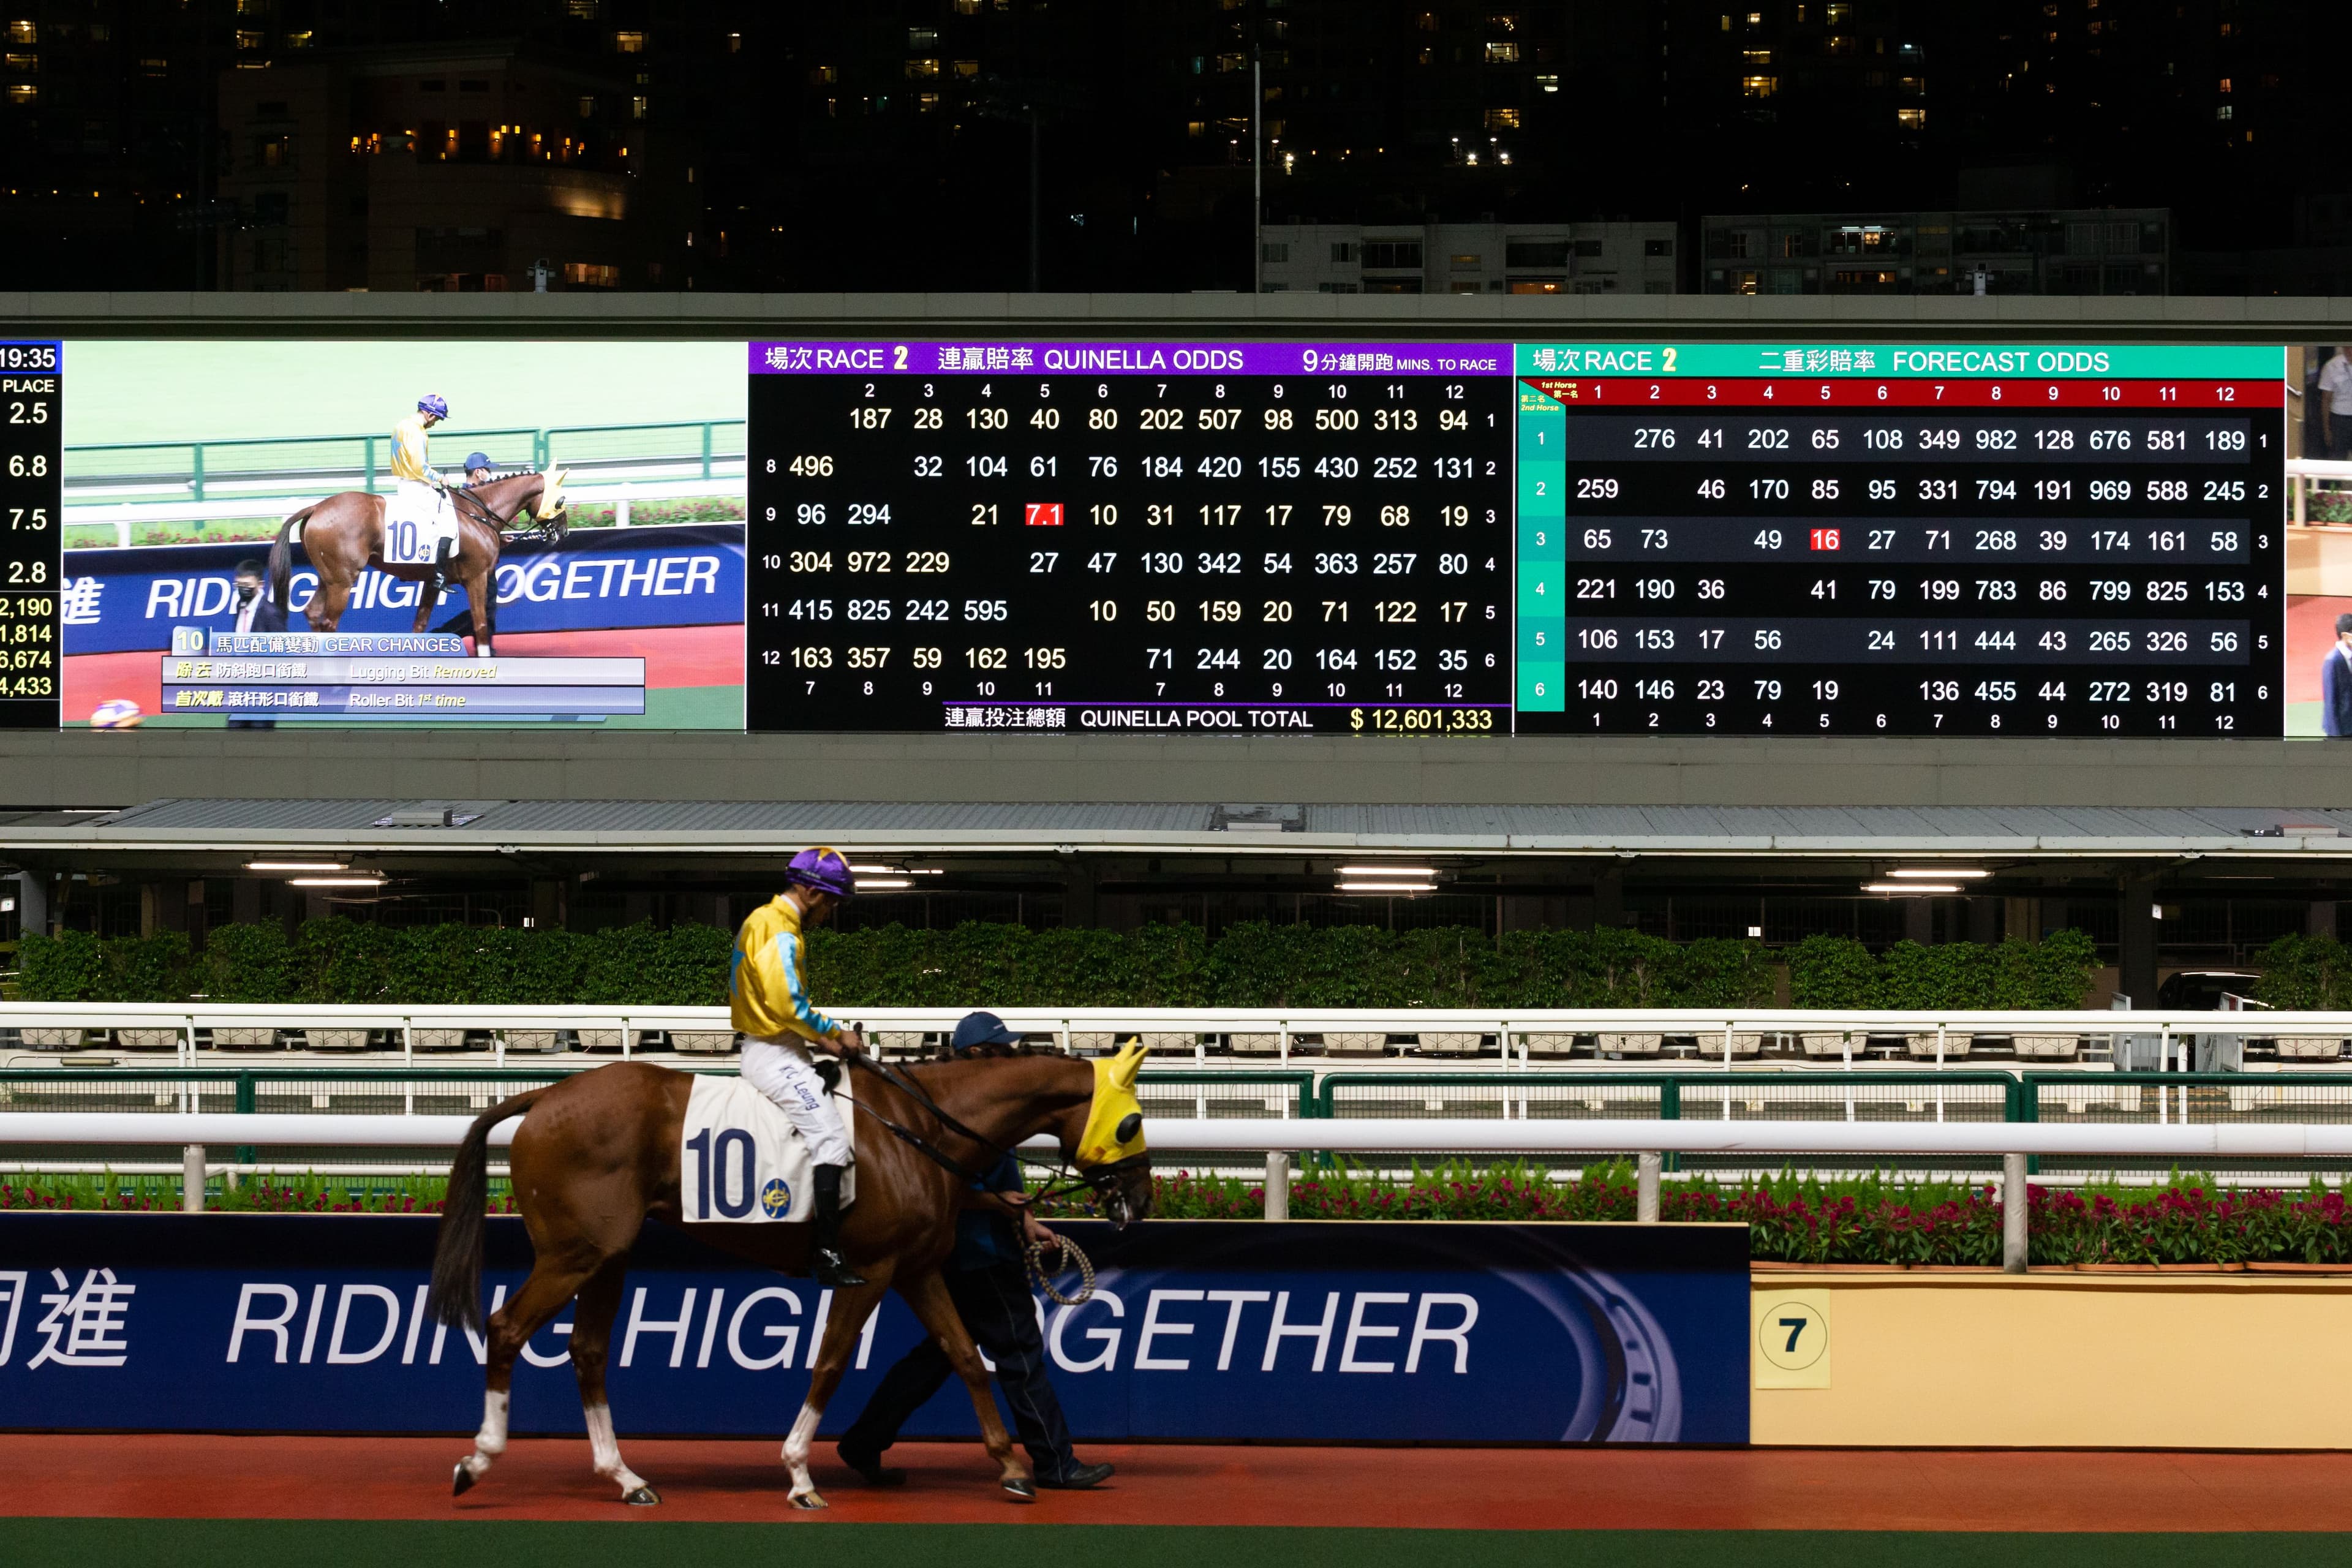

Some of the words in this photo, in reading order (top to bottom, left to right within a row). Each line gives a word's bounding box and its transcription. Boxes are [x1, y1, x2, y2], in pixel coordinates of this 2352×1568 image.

[0, 348, 56, 368] 19:35
[766, 347, 812, 370] 場次
[817, 349, 884, 369] RACE
[894, 345, 908, 370] 2
[938, 347, 1034, 371] 連贏賠率
[1044, 349, 1167, 370] QUINELLA
[1173, 350, 1243, 370] ODDS
[1396, 360, 1433, 371] MINS.
[1437, 359, 1457, 371] TO
[1460, 359, 1497, 371] RACE
[1532, 349, 1580, 372] 場次
[1585, 350, 1652, 371] RACE
[1662, 347, 1677, 372] 2
[1759, 349, 1875, 372] 二重彩賠率
[1894, 351, 2030, 372] FORECAST
[2037, 352, 2109, 372] ODDS
[3, 379, 55, 393] PLACE
[865, 383, 875, 398] 2
[924, 383, 933, 398] 3
[981, 383, 992, 398] 4
[1040, 383, 1050, 398] 5
[1098, 383, 1108, 398] 6
[1157, 384, 1167, 398] 7
[1215, 384, 1226, 398] 8
[1273, 384, 1283, 398] 9
[1329, 384, 1347, 399] 10
[1387, 385, 1403, 399] 11
[1446, 385, 1464, 399] 12
[1594, 385, 1601, 399] 1
[1650, 385, 1660, 399] 2
[1707, 385, 1717, 399] 3
[1763, 385, 1774, 399] 4
[1821, 385, 1831, 400] 5
[1877, 385, 1887, 400] 6
[1934, 386, 1945, 400] 7
[1991, 386, 2002, 400] 8
[2048, 386, 2059, 401] 9
[2102, 386, 2120, 401] 10
[2160, 386, 2176, 401] 11
[2216, 386, 2234, 401] 12
[9, 402, 48, 424] 2.5
[850, 408, 892, 429] 187
[914, 408, 943, 429] 28
[967, 408, 1008, 429] 130
[1030, 409, 1060, 429] 40
[1088, 409, 1118, 430] 80
[1140, 409, 1183, 430] 202
[1198, 409, 1242, 430] 507
[1264, 409, 1293, 430] 98
[1315, 409, 1359, 431] 500
[1374, 409, 1417, 431] 313
[1439, 409, 1468, 431] 94
[1487, 413, 1494, 428] 1
[1537, 431, 1544, 445] 1
[1634, 428, 1675, 448] 276
[1697, 429, 1722, 448] 41
[1747, 429, 1789, 449] 202
[1812, 429, 1839, 449] 65
[1863, 429, 1903, 450] 108
[1919, 429, 1960, 450] 349
[1976, 429, 2017, 450] 982
[2034, 429, 2074, 450] 128
[2089, 430, 2131, 450] 676
[2147, 430, 2185, 450] 581
[2205, 431, 2245, 451] 189
[2260, 434, 2266, 448] 1
[9, 454, 47, 477] 6.8
[9, 508, 47, 530] 7.5
[766, 507, 776, 521] 9
[797, 503, 826, 525] 96
[848, 503, 891, 525] 294
[971, 504, 997, 525] 21
[1027, 504, 1059, 526] 7.1
[1090, 504, 1117, 526] 10
[1147, 505, 1172, 526] 31
[1199, 505, 1242, 526] 117
[1265, 505, 1293, 526] 17
[1322, 505, 1351, 526] 79
[1381, 505, 1410, 527] 68
[1441, 505, 1468, 527] 19
[1486, 509, 1496, 524] 3
[387, 521, 417, 561] 10
[1536, 532, 1545, 546] 3
[1584, 529, 1611, 549] 65
[1641, 529, 1668, 549] 73
[1754, 529, 1782, 549] 49
[1813, 529, 1839, 549] 16
[1868, 530, 1896, 549] 27
[1925, 530, 1950, 550] 71
[1975, 530, 2017, 551] 268
[2039, 530, 2067, 551] 39
[9, 561, 47, 583] 2.8
[177, 631, 204, 650] 10
[216, 635, 319, 654] 馬匹配備變動
[325, 638, 373, 652] GEAR
[377, 638, 461, 652] CHANGES
[762, 650, 780, 665] 12
[791, 647, 832, 668] 163
[847, 647, 891, 668] 357
[913, 647, 942, 668] 59
[965, 647, 1007, 669] 162
[1024, 647, 1066, 669] 195
[1147, 648, 1172, 669] 71
[1197, 648, 1241, 669] 244
[1263, 649, 1292, 670] 20
[1316, 649, 1358, 670] 164
[1374, 649, 1416, 670] 152
[1439, 649, 1468, 671] 35
[1485, 653, 1495, 668] 6
[350, 664, 405, 681] Lugging
[410, 664, 429, 678] Bit
[433, 665, 497, 679] Removed
[349, 693, 391, 707] Roller
[394, 693, 414, 707] Bit
[418, 693, 432, 706] 1st
[435, 694, 467, 707] time
[944, 707, 1066, 728] 連贏投注總額
[1080, 710, 1182, 729] QUINELLA
[1186, 710, 1243, 727] POOL
[1248, 710, 1314, 728] TOTAL
[1351, 707, 1364, 731] $
[1372, 709, 1492, 731] 12,601,333
[793, 1081, 820, 1110] Leung
[686, 1128, 756, 1219] 10
[1778, 1317, 1807, 1353] 7
